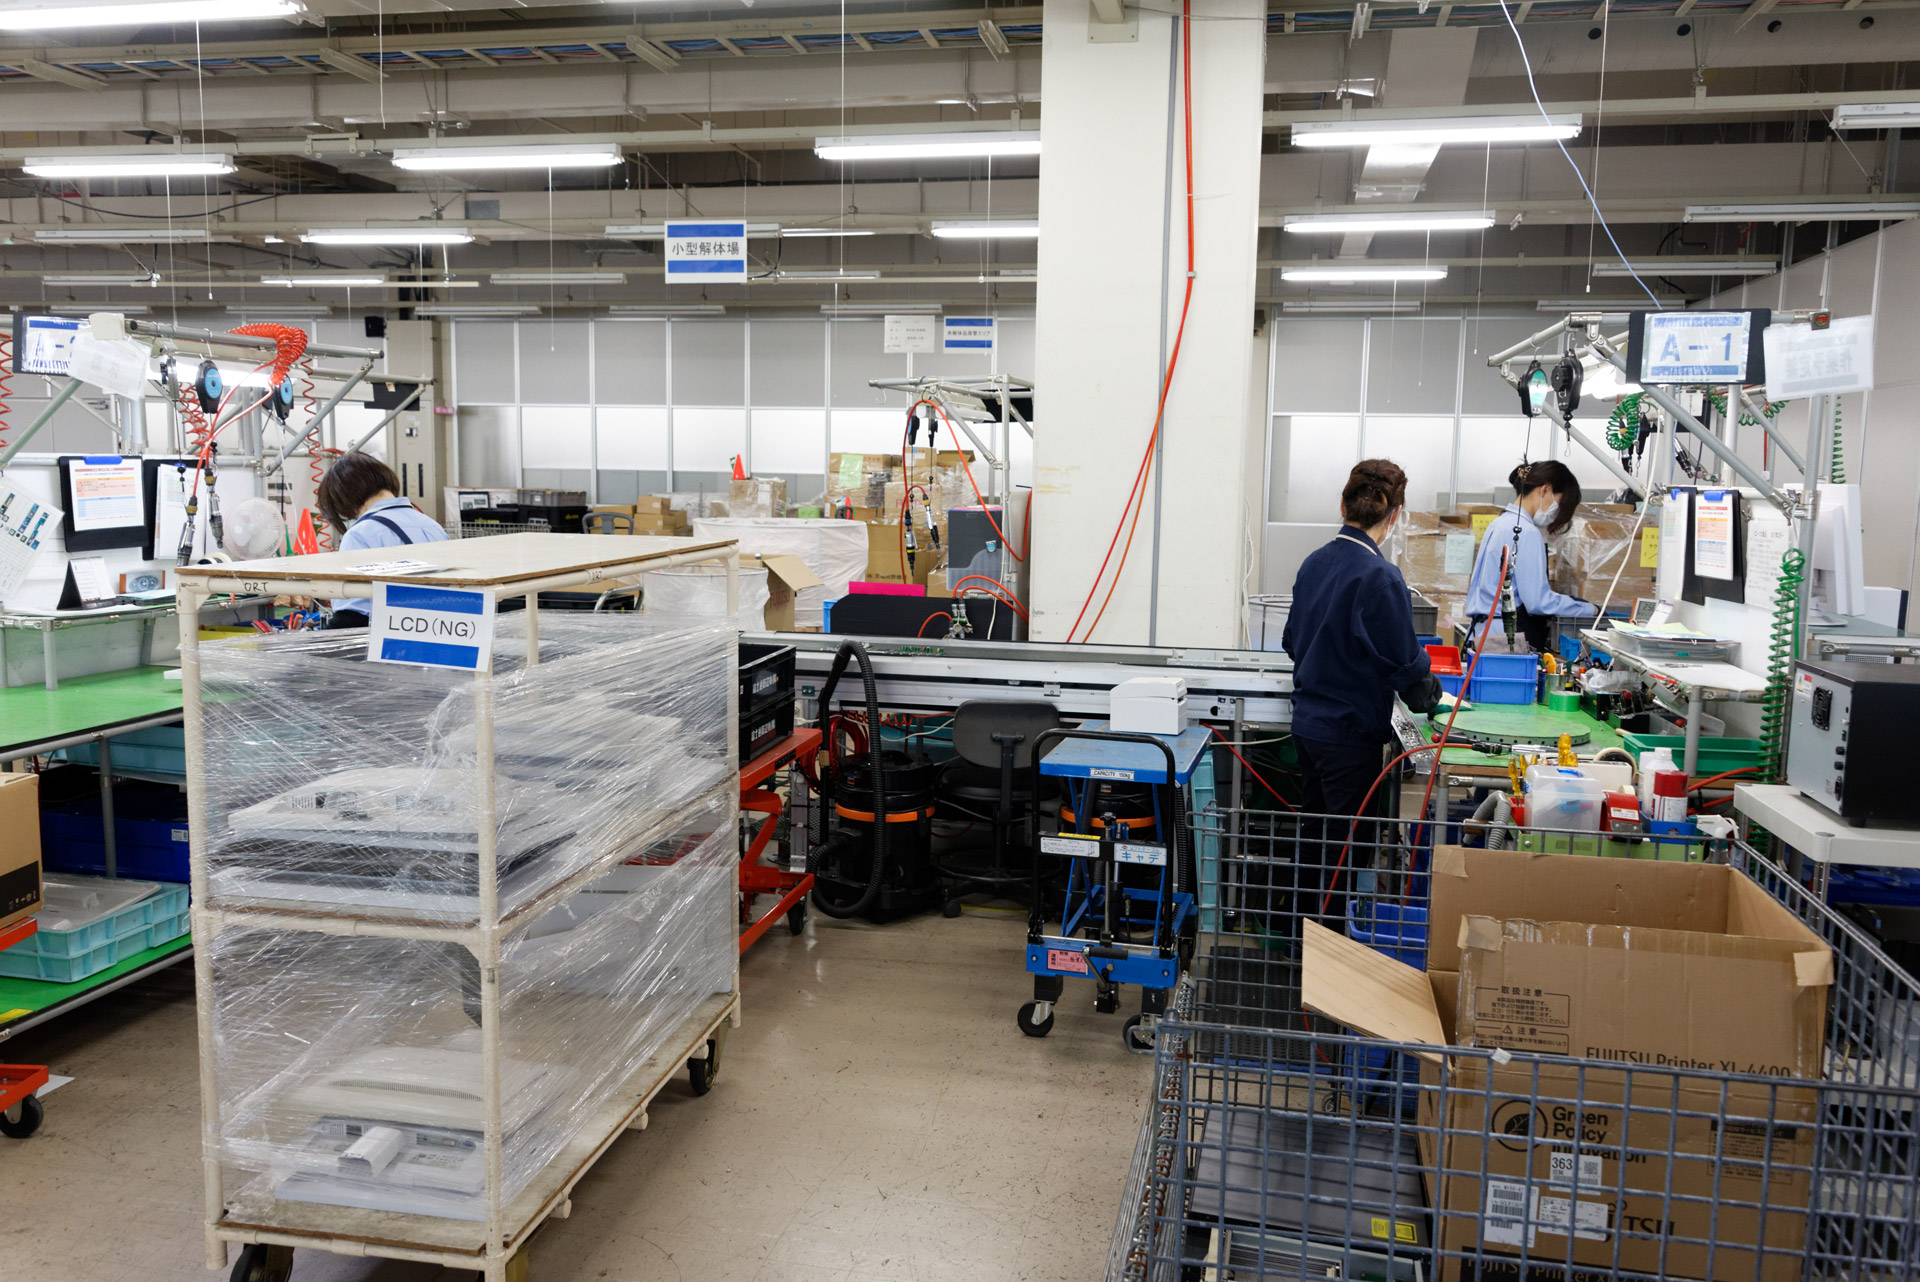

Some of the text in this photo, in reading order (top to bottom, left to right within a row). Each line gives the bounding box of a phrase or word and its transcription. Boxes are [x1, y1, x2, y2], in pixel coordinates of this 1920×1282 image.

[672, 241, 740, 256] 小型解体場
[244, 581, 269, 593] ORT
[388, 615, 476, 640] LCD(NG)
[1501, 986, 1543, 997] 取扱注意
[1518, 1026, 1537, 1036] 注意
[1553, 1122, 1607, 1144] Poicy
